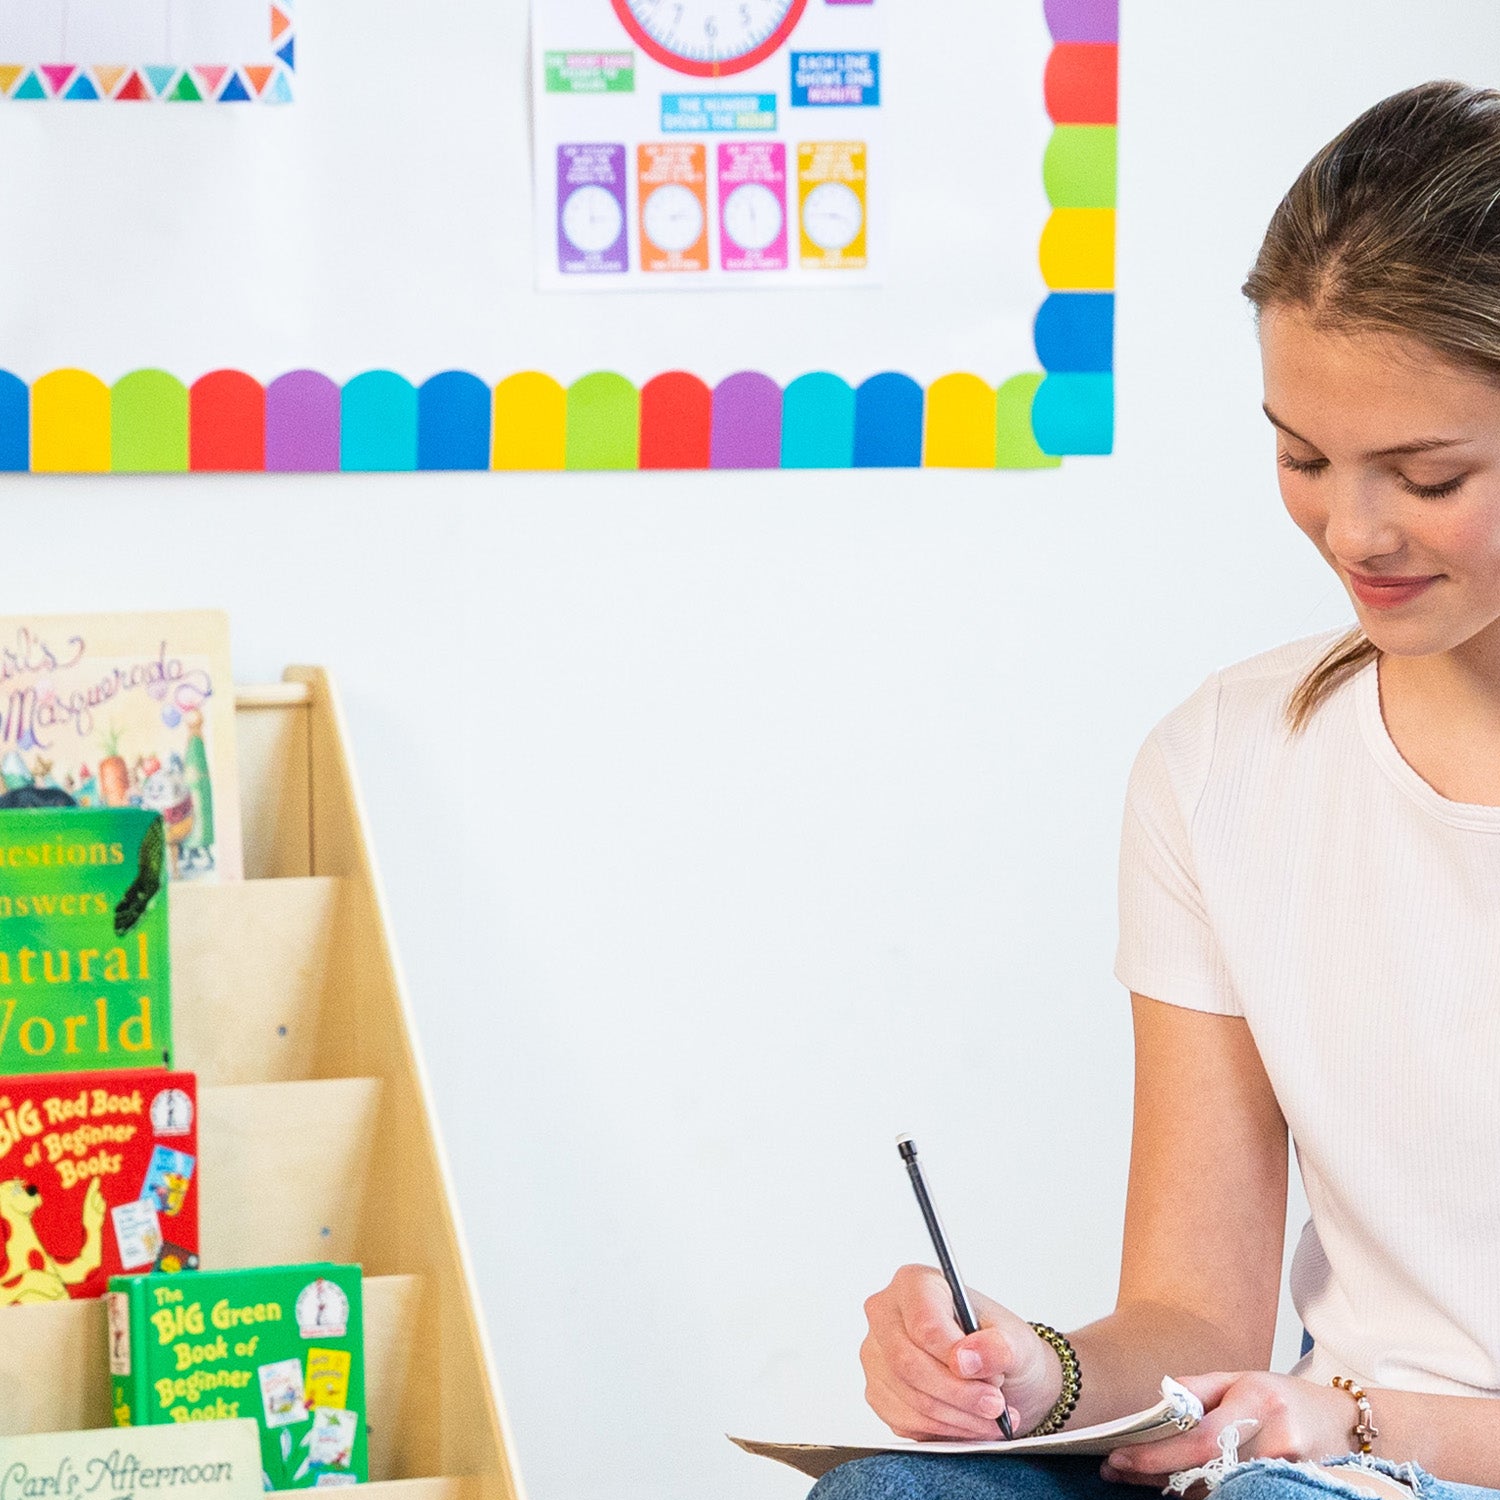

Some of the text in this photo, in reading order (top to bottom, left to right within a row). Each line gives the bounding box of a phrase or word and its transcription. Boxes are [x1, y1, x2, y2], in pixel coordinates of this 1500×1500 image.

[704, 16, 718, 38] 6
[0, 835, 124, 868] estions
[0, 892, 108, 917] nswers
[42, 1090, 88, 1125] Red
[90, 1089, 142, 1117] Book
[23, 1142, 41, 1168] of
[42, 1124, 137, 1163] Beginner
[54, 1149, 122, 1190] Books
[153, 1286, 184, 1306] The
[151, 1299, 283, 1345] BIG Green
[173, 1335, 259, 1371] Book of
[154, 1370, 252, 1408] Beginner
[169, 1397, 240, 1424] Books
[86, 1449, 233, 1490] Afternoon
